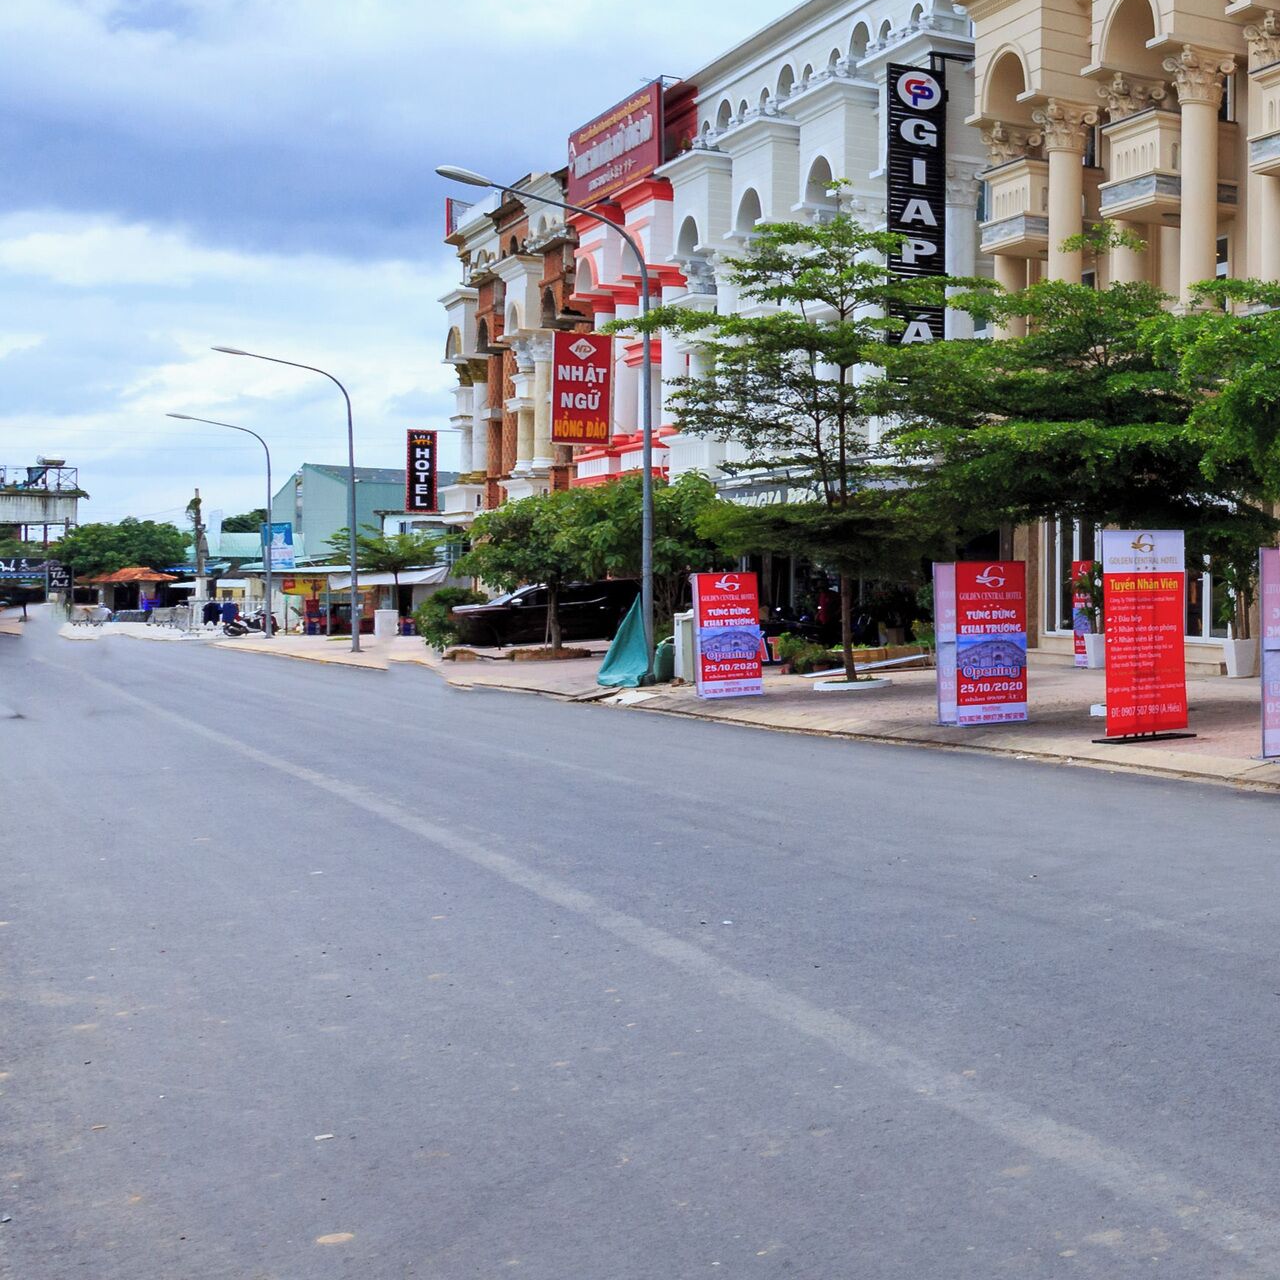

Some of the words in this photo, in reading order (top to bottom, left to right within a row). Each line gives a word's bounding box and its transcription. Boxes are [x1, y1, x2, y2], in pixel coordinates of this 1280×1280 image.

[558, 363, 607, 388] NHẬT
[561, 389, 601, 410] NGỮ
[414, 448, 430, 507] HOTEL
[1108, 557, 1133, 565] GOLDEN
[1134, 556, 1159, 565] CENTRAL
[1160, 556, 1178, 564] HOTEL
[963, 665, 1019, 679] Opening
[960, 682, 1023, 693] 25/10/2020
